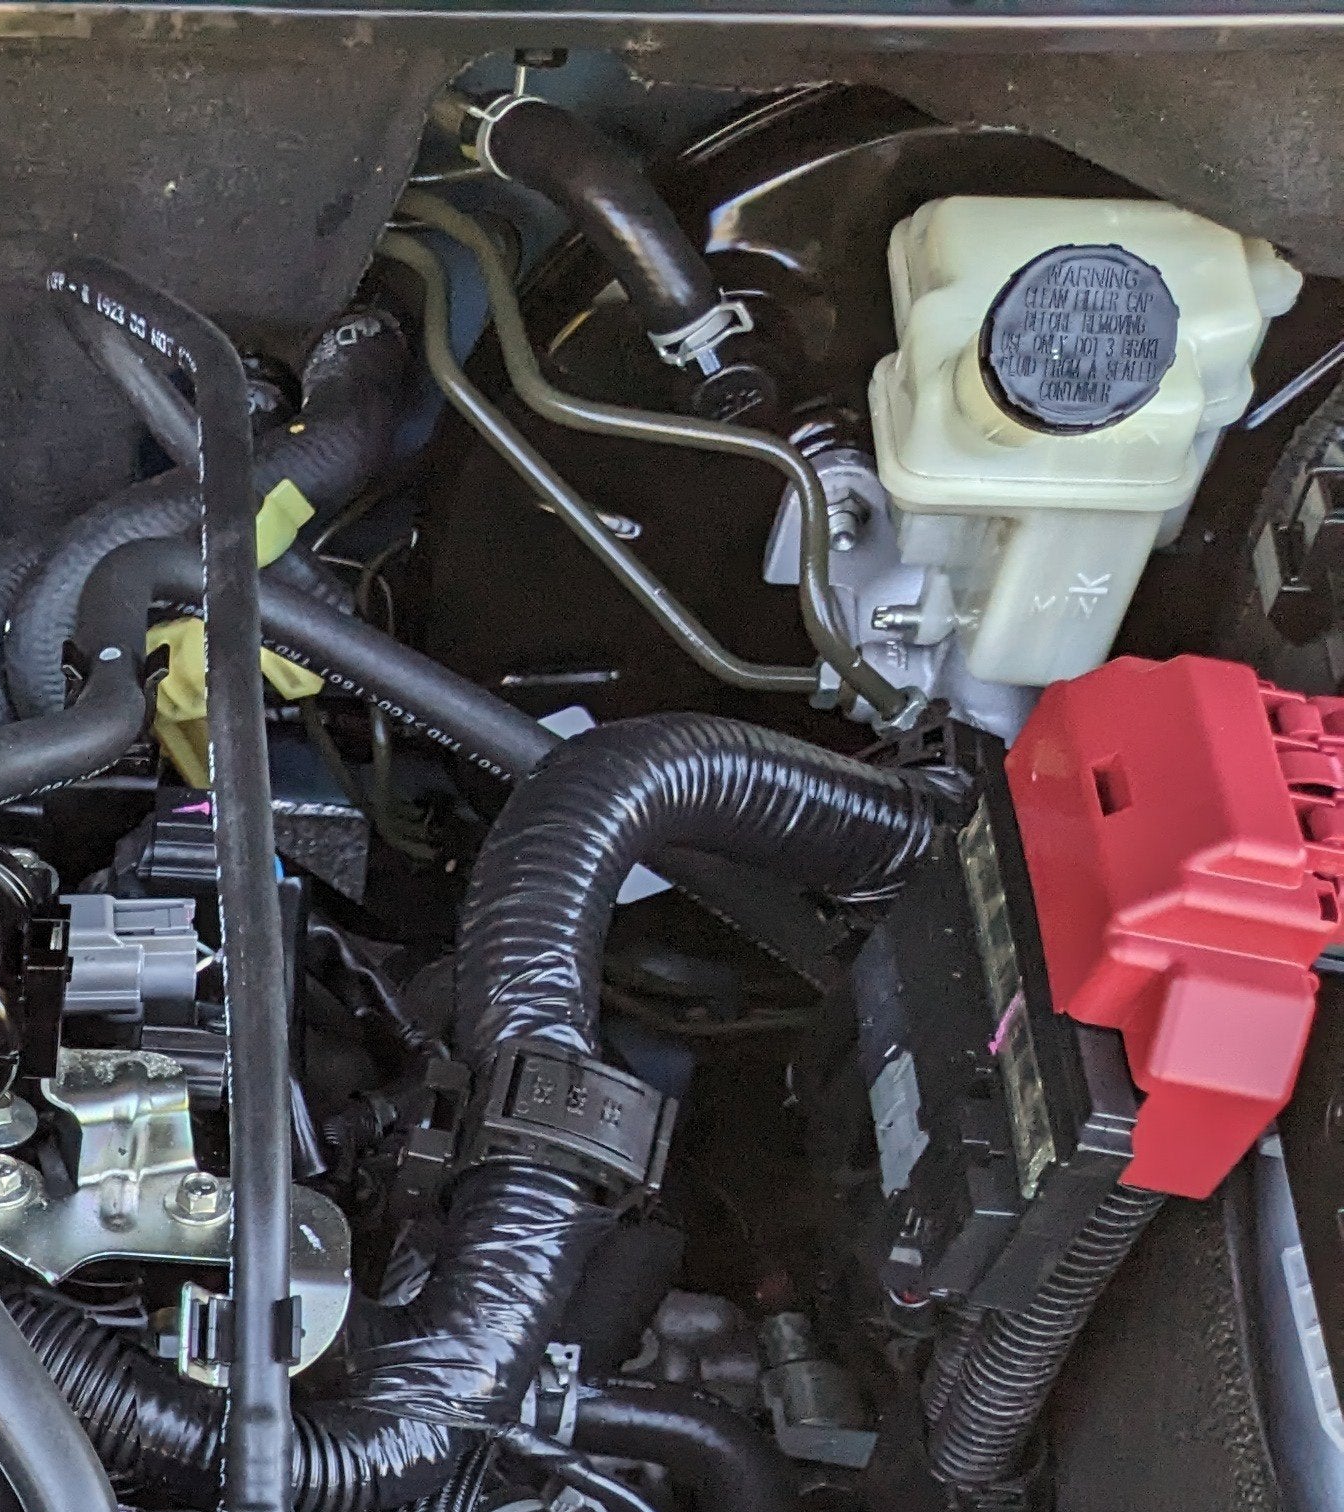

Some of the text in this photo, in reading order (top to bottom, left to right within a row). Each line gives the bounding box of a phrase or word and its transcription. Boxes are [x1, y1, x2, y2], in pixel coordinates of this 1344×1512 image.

[1047, 264, 1139, 289] WARNING
[1024, 287, 1154, 313] CLEAN FILLER CAP
[1023, 310, 1146, 335] BEFORE REMOVING
[1001, 332, 1159, 359] USE ONLY DOT 3 BRAKE
[999, 355, 1158, 381] FLUID FROM A SEALED
[1038, 380, 1112, 403] CONTAINER
